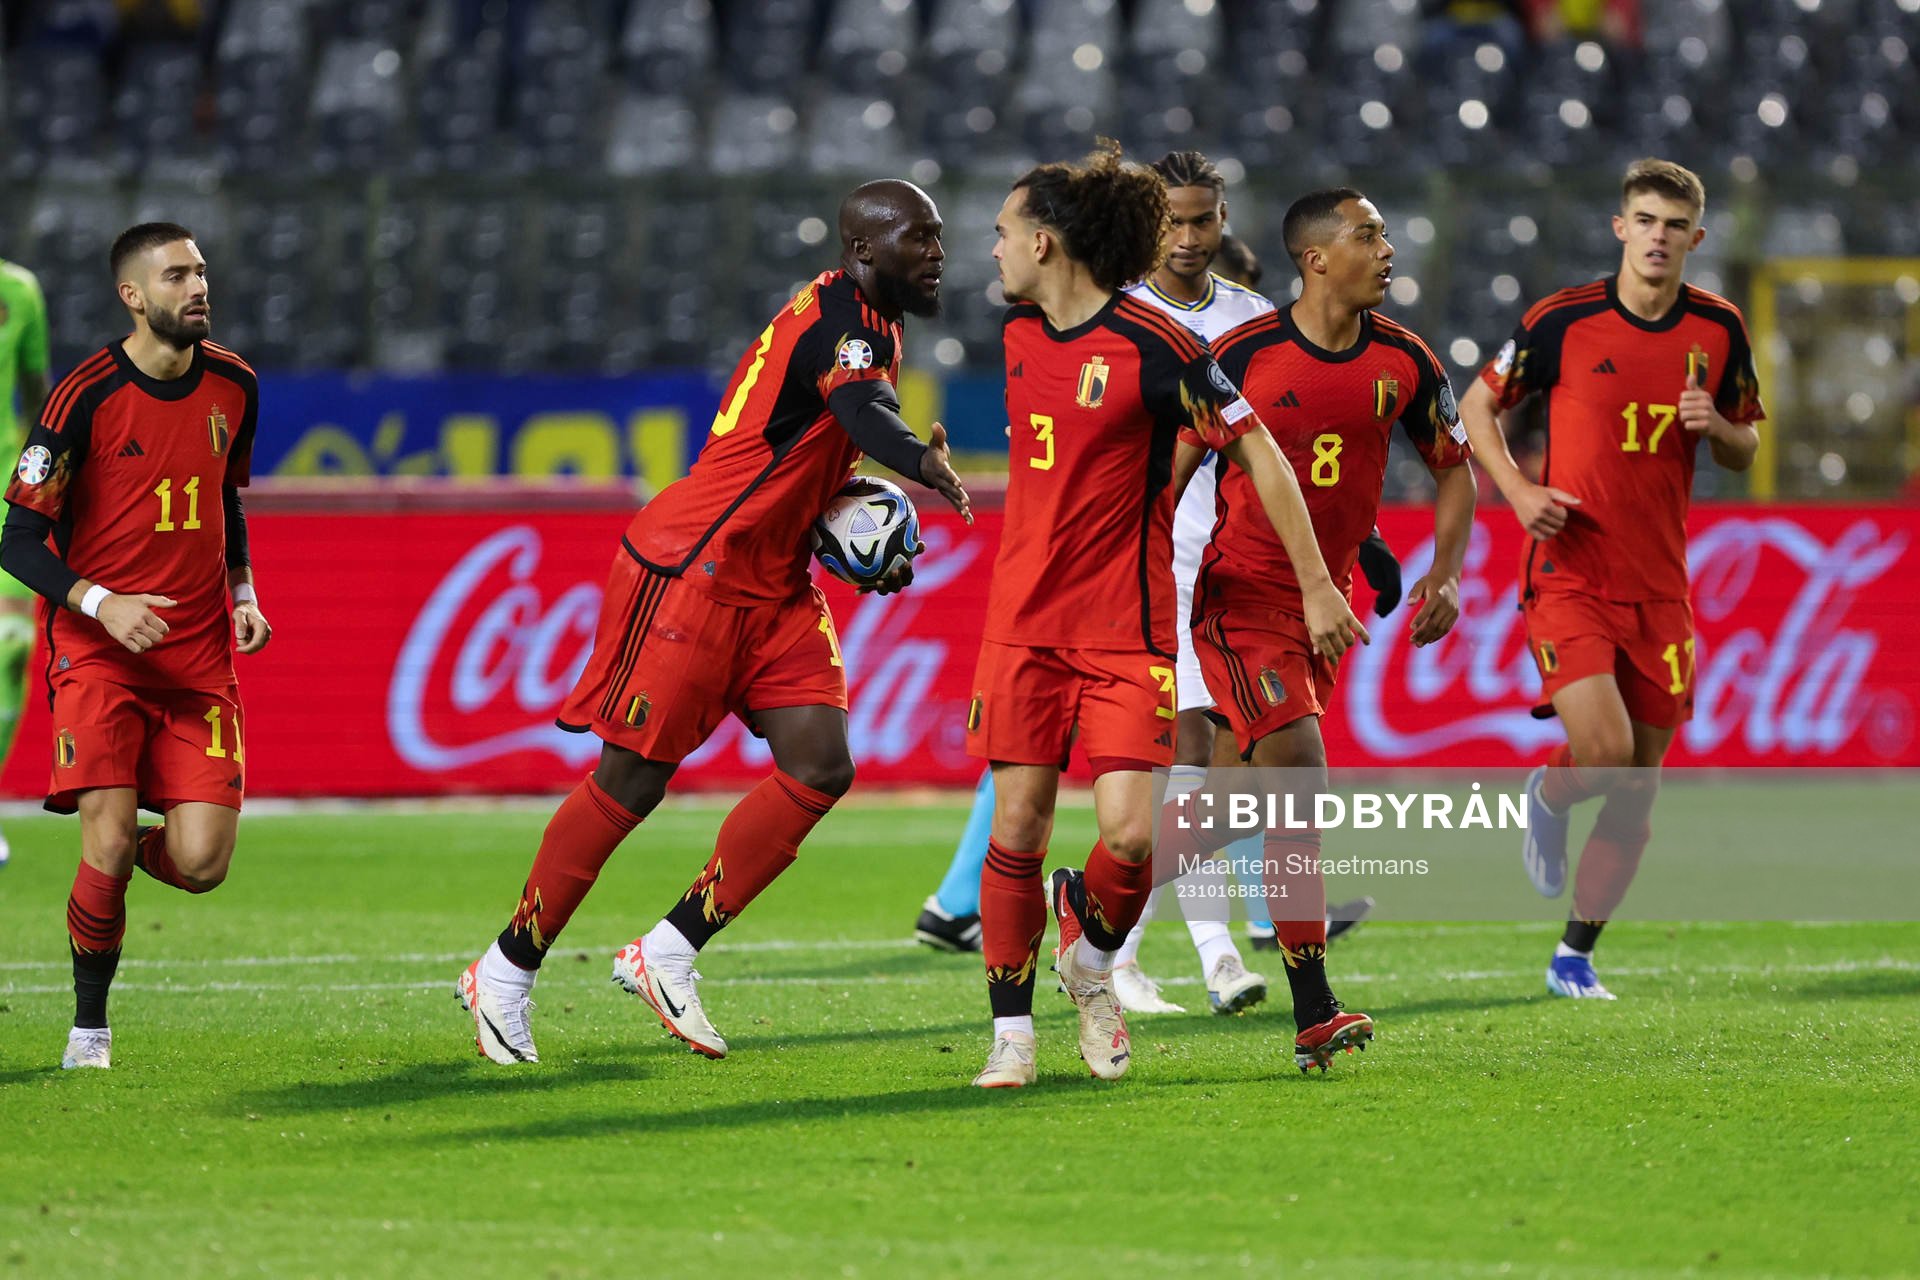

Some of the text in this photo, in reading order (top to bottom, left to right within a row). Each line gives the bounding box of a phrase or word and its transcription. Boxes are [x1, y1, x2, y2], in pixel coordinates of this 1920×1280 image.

[1030, 414, 1055, 470] 3
[1622, 402, 1677, 453] 17
[1311, 433, 1343, 487] 8
[154, 476, 201, 532] 11
[1149, 666, 1176, 720] 3
